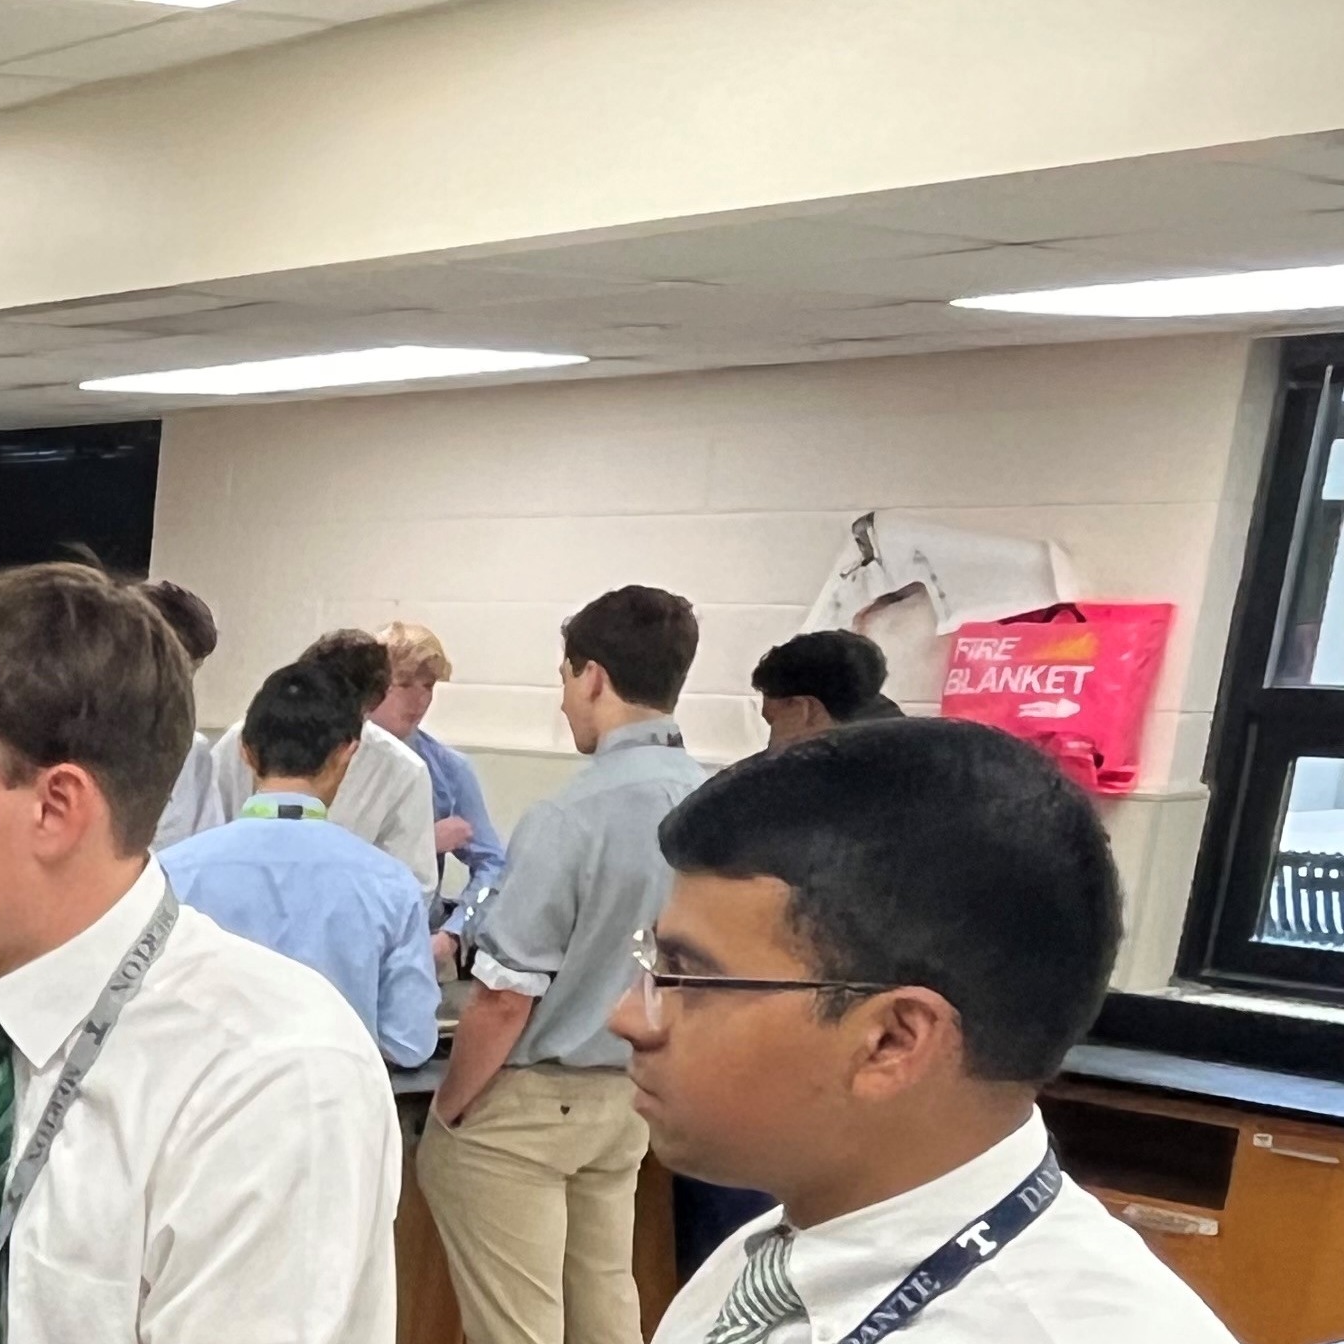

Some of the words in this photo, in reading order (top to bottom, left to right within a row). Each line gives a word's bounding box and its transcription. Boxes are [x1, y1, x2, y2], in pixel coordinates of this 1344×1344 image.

[953, 636, 1021, 662] FIRE
[943, 664, 1095, 696] BLANKET
[956, 1220, 998, 1257] T
